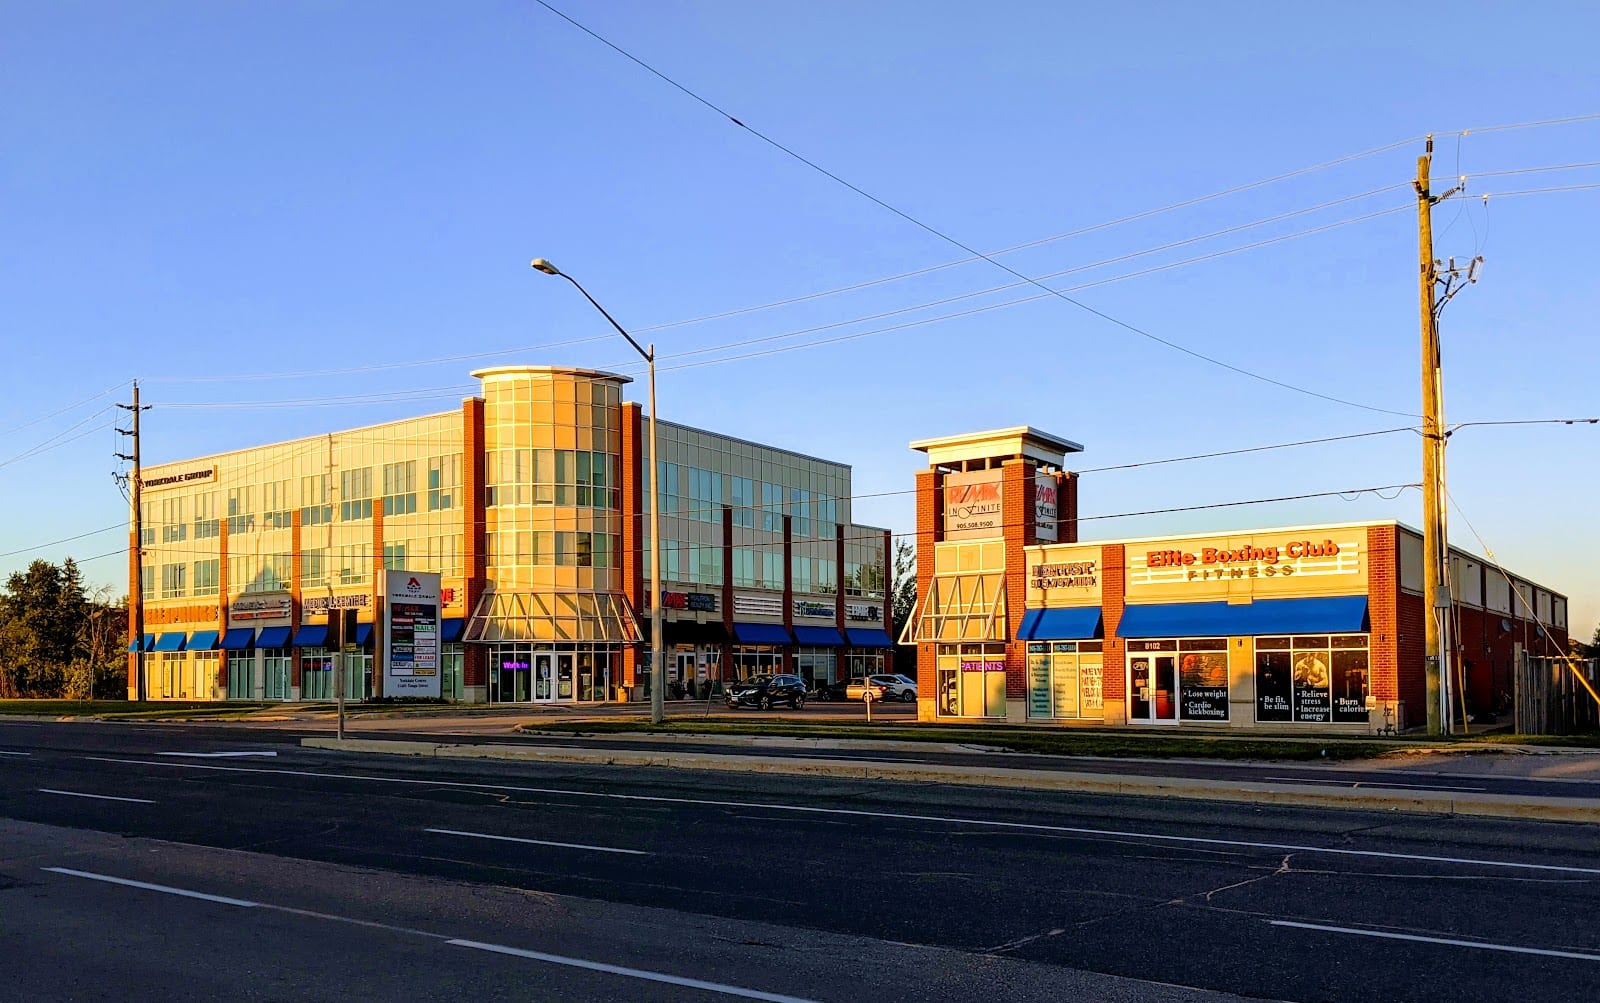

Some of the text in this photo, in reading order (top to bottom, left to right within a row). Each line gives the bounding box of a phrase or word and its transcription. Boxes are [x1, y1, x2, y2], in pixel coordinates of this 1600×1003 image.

[144, 469, 213, 488] YORKDALE GROUP
[949, 482, 1001, 503] RE/MAX
[1147, 539, 1340, 568] Elite Boxing Club
[1188, 565, 1294, 581] FITNESS
[961, 661, 1004, 671] PATIENTS
[1188, 689, 1227, 700] Lose weight
[1301, 690, 1329, 698] Relieve
[1264, 695, 1286, 704] Be fit,
[1340, 697, 1358, 706] Burn
[1188, 701, 1212, 709] Cardio
[1301, 705, 1331, 713] Increase
[1188, 708, 1225, 717] kickboxing
[1300, 713, 1325, 722] energy
